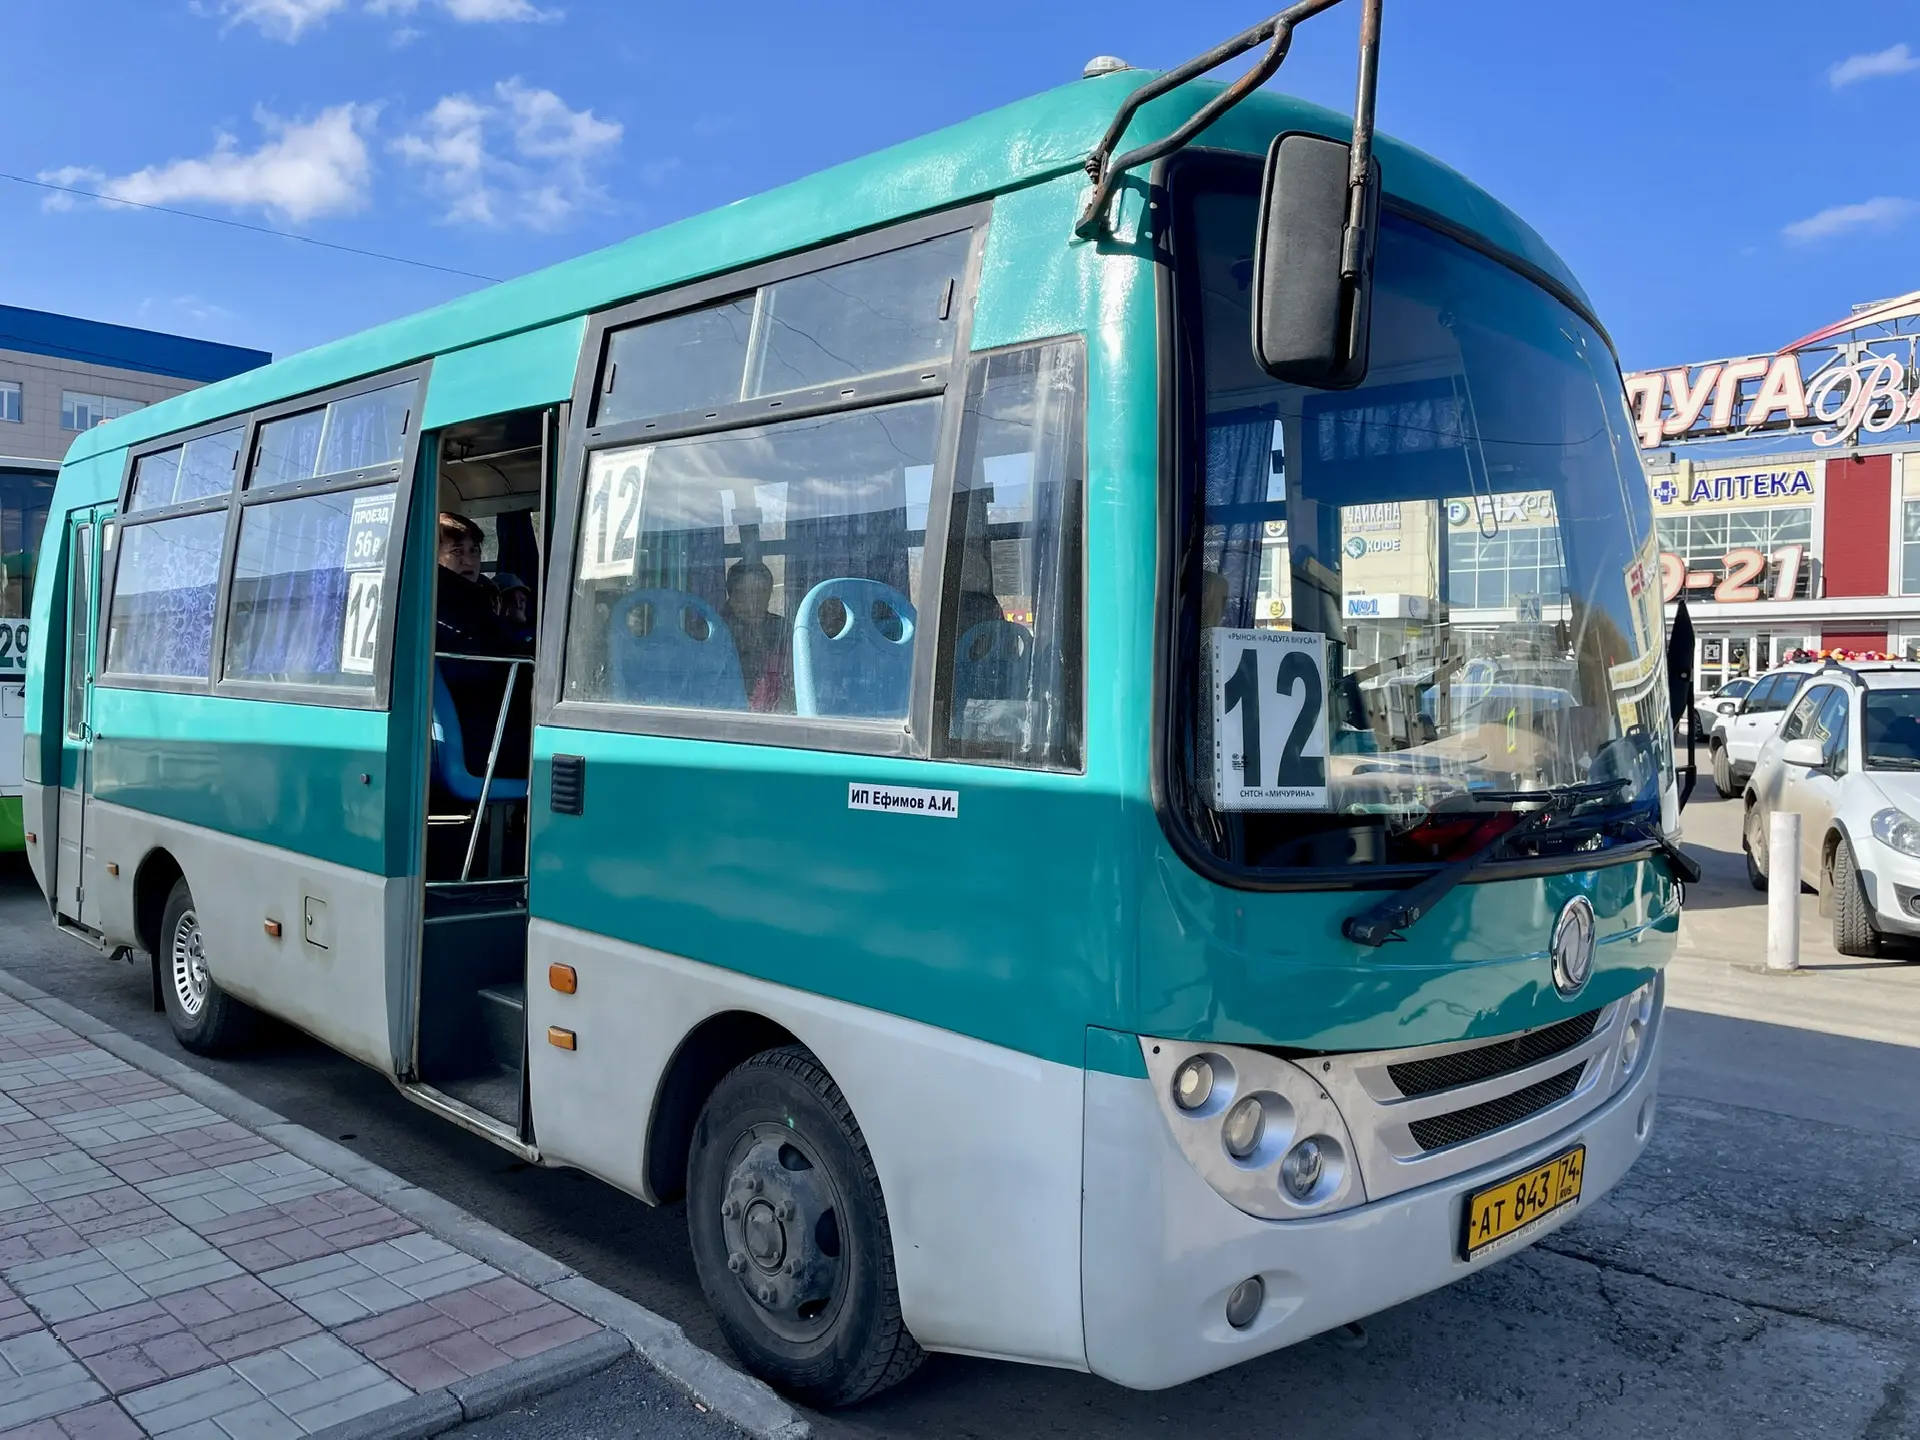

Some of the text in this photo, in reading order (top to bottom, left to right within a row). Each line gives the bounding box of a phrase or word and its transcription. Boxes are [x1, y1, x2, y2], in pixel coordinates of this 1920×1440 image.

[1805, 353, 1920, 446] В
[1691, 470, 1814, 500] АПТЕКА
[354, 507, 389, 525] ПРОЕЗД
[592, 465, 641, 563] 12
[1367, 539, 1401, 552] КОФЕ
[350, 583, 379, 659] 12
[0, 624, 30, 669] 29
[1258, 634, 1290, 644] «РАДУГА
[1224, 648, 1326, 787] 12
[851, 789, 955, 811] ИП Ефимов А.И.
[1265, 789, 1315, 798] «МИЧУРИНА»
[1514, 1170, 1551, 1221] 843
[1560, 1155, 1577, 1188] 74
[1560, 1185, 1573, 1199] RUS
